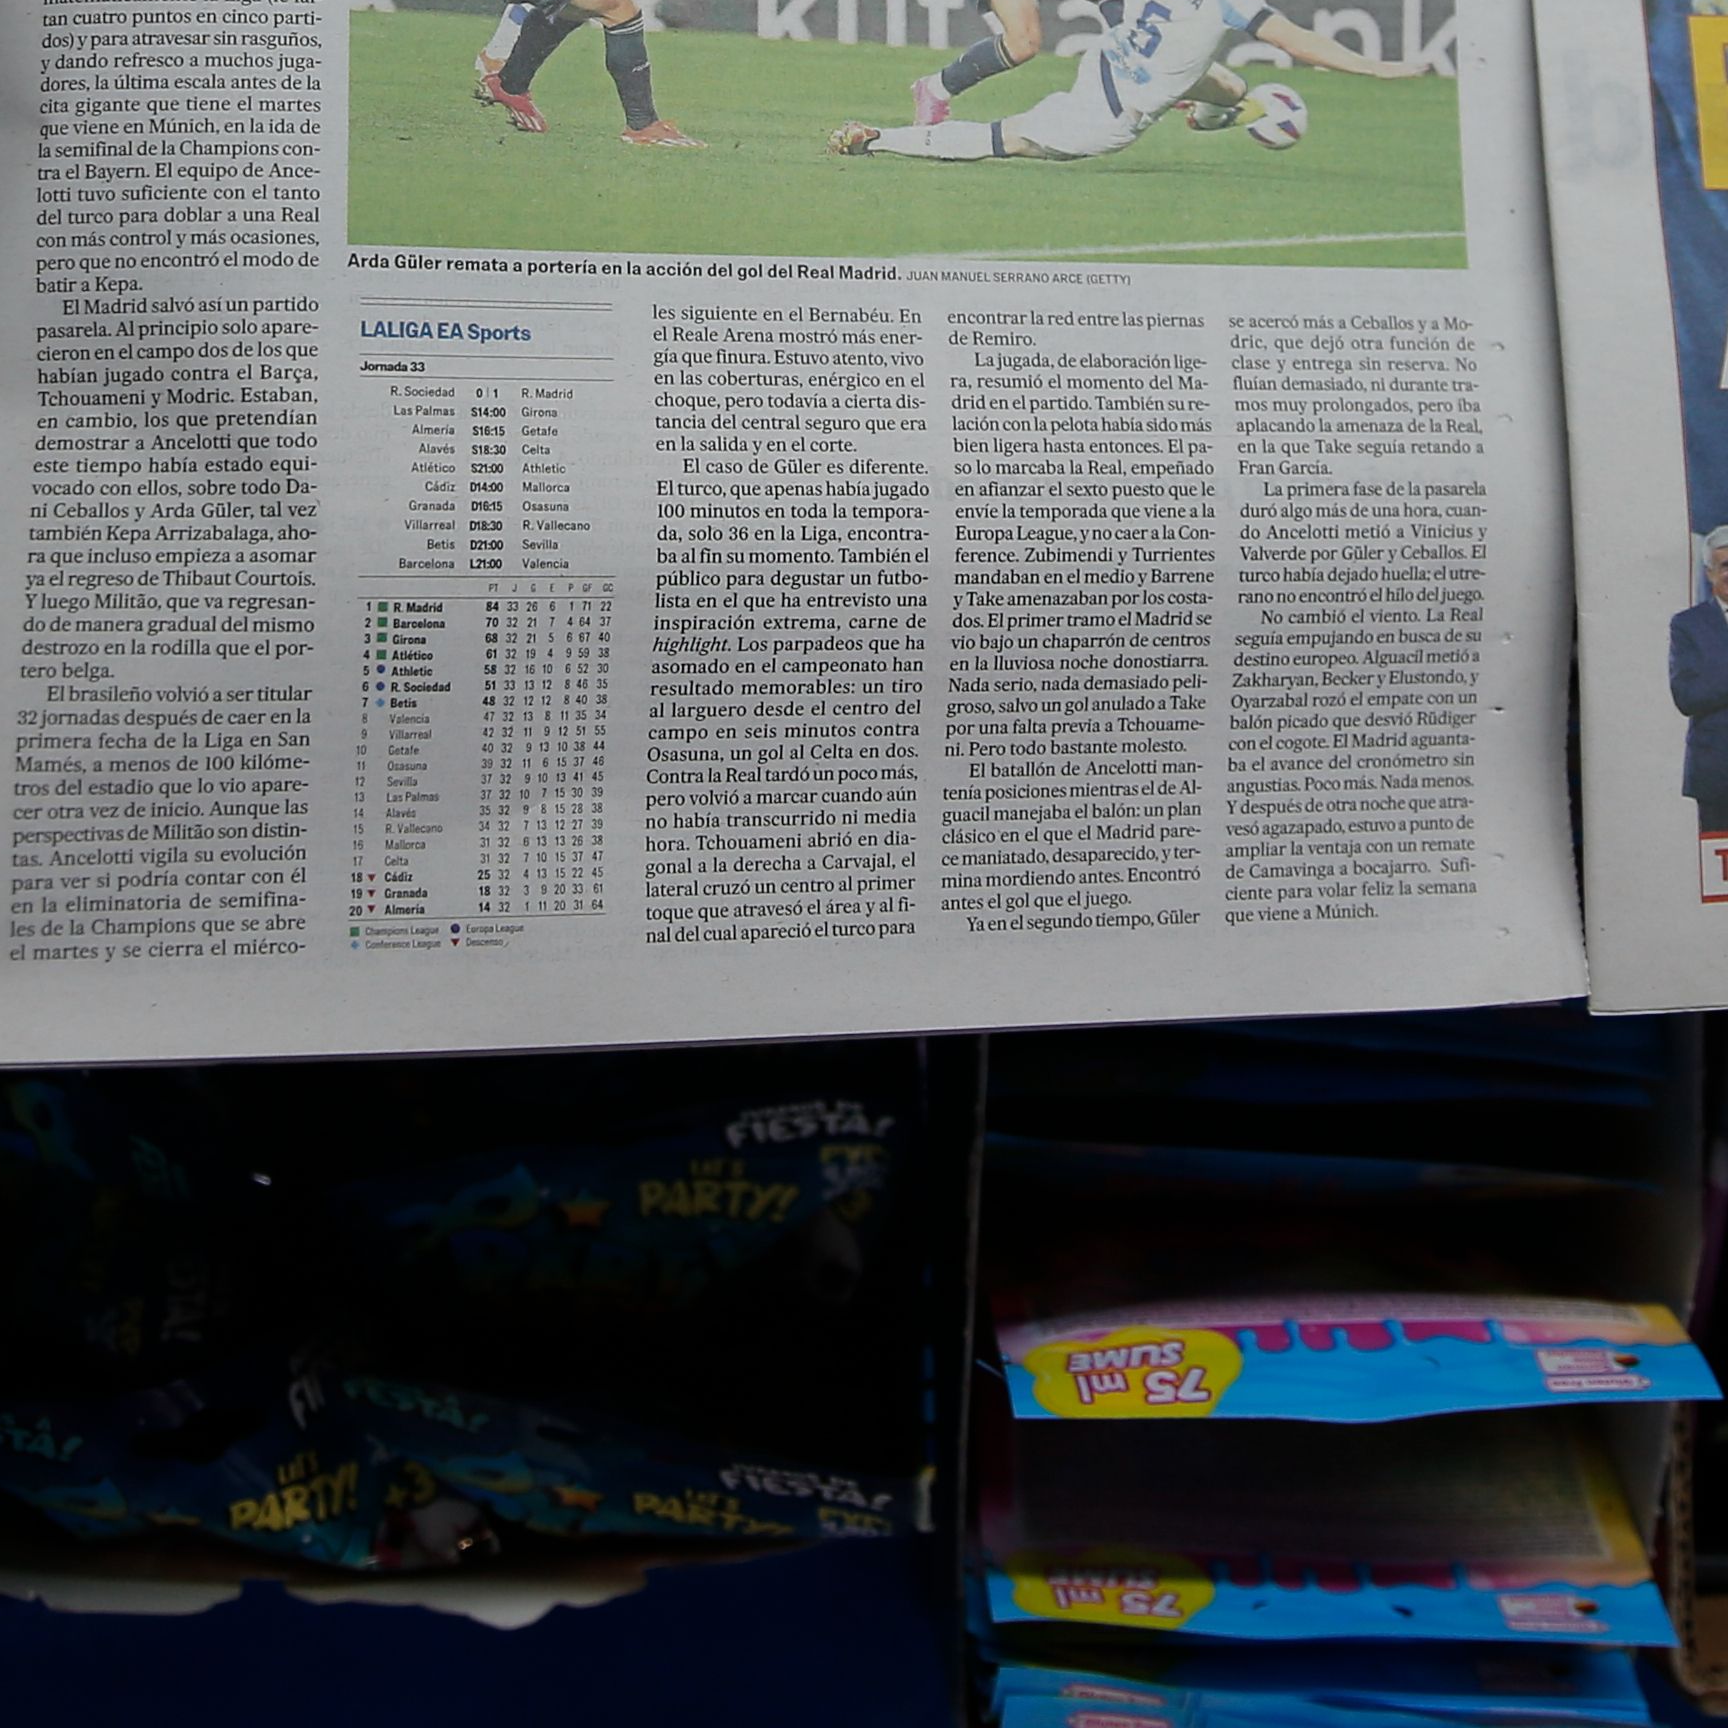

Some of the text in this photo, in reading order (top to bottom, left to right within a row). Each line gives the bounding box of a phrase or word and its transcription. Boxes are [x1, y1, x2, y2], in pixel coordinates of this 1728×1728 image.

[360, 320, 532, 346] LALIGA EA Sports
[1145, 1365, 1212, 1406] 75
